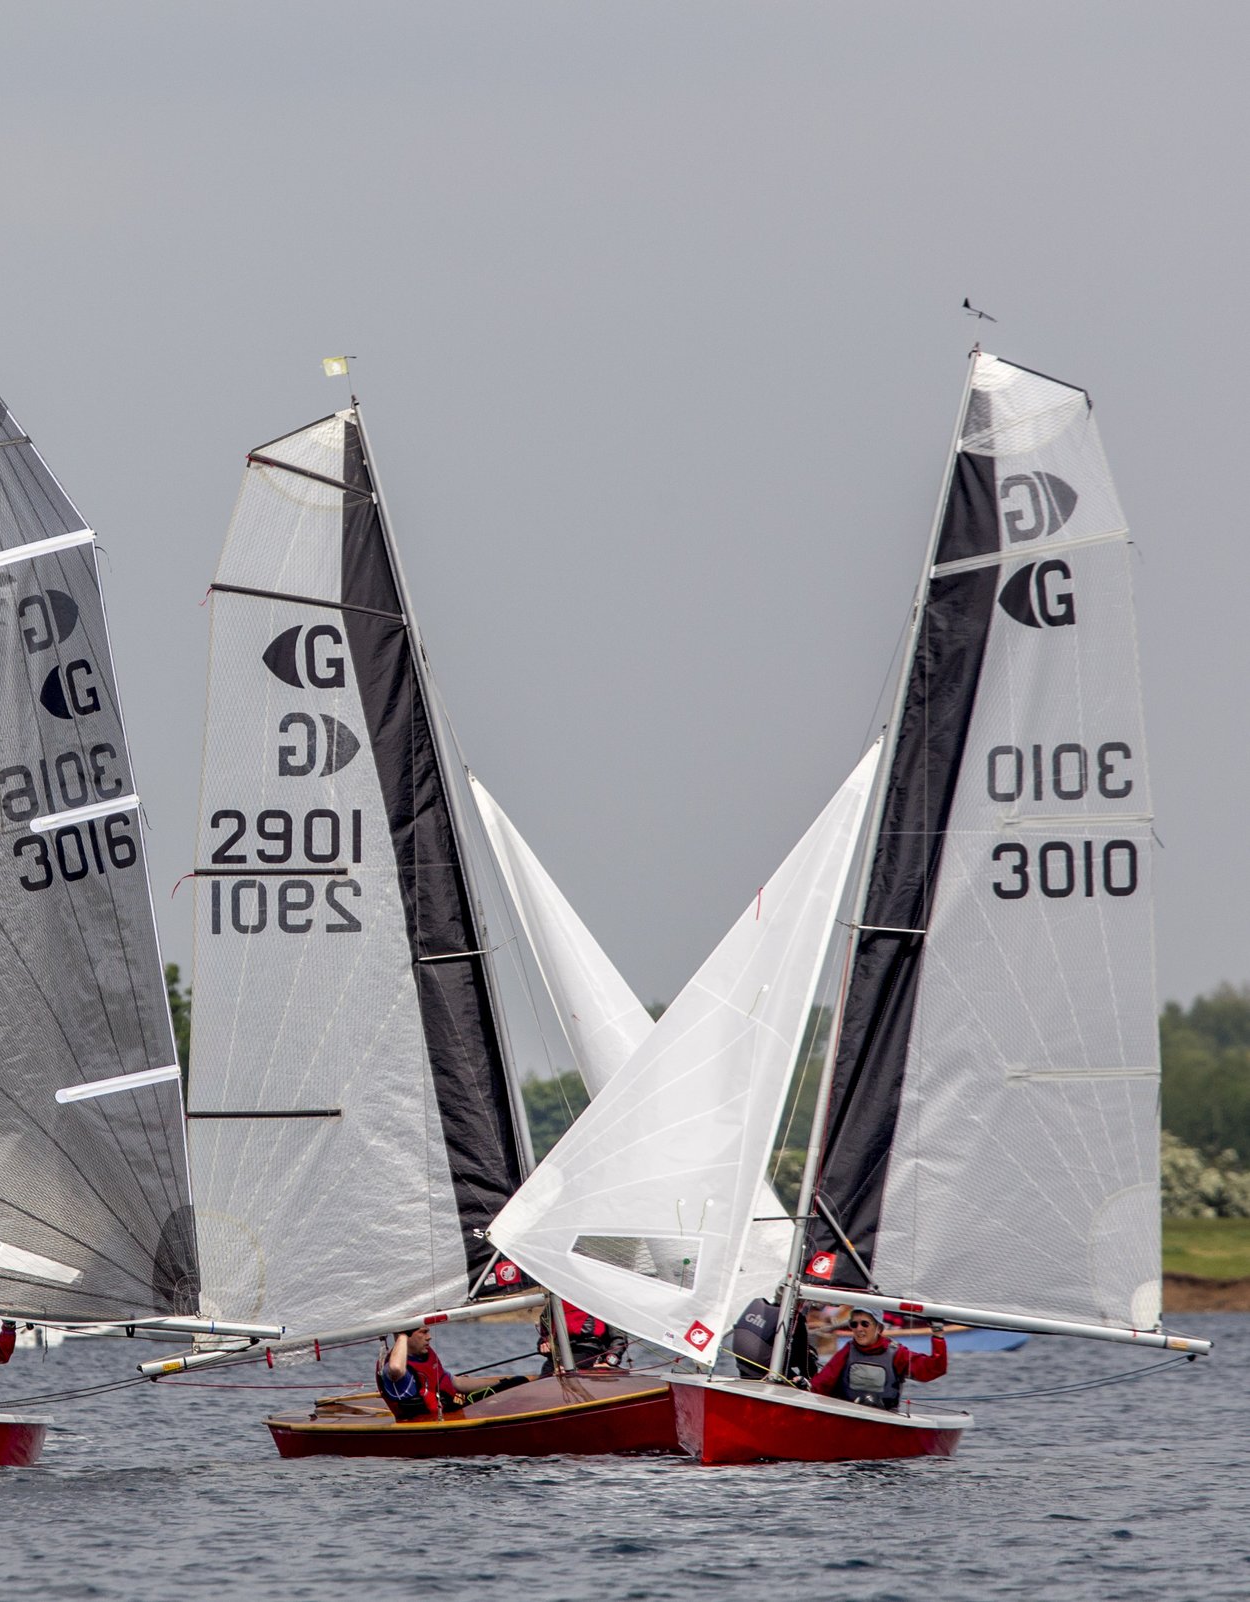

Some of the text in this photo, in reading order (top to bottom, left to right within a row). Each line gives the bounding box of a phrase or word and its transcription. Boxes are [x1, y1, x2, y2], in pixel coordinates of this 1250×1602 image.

[1036, 559, 1076, 627] G
[304, 624, 346, 689] G
[65, 658, 101, 716] G
[13, 812, 137, 892] 3016
[210, 808, 362, 864] 2901
[991, 839, 1138, 899] 3010
[745, 1313, 767, 1329] Gill
